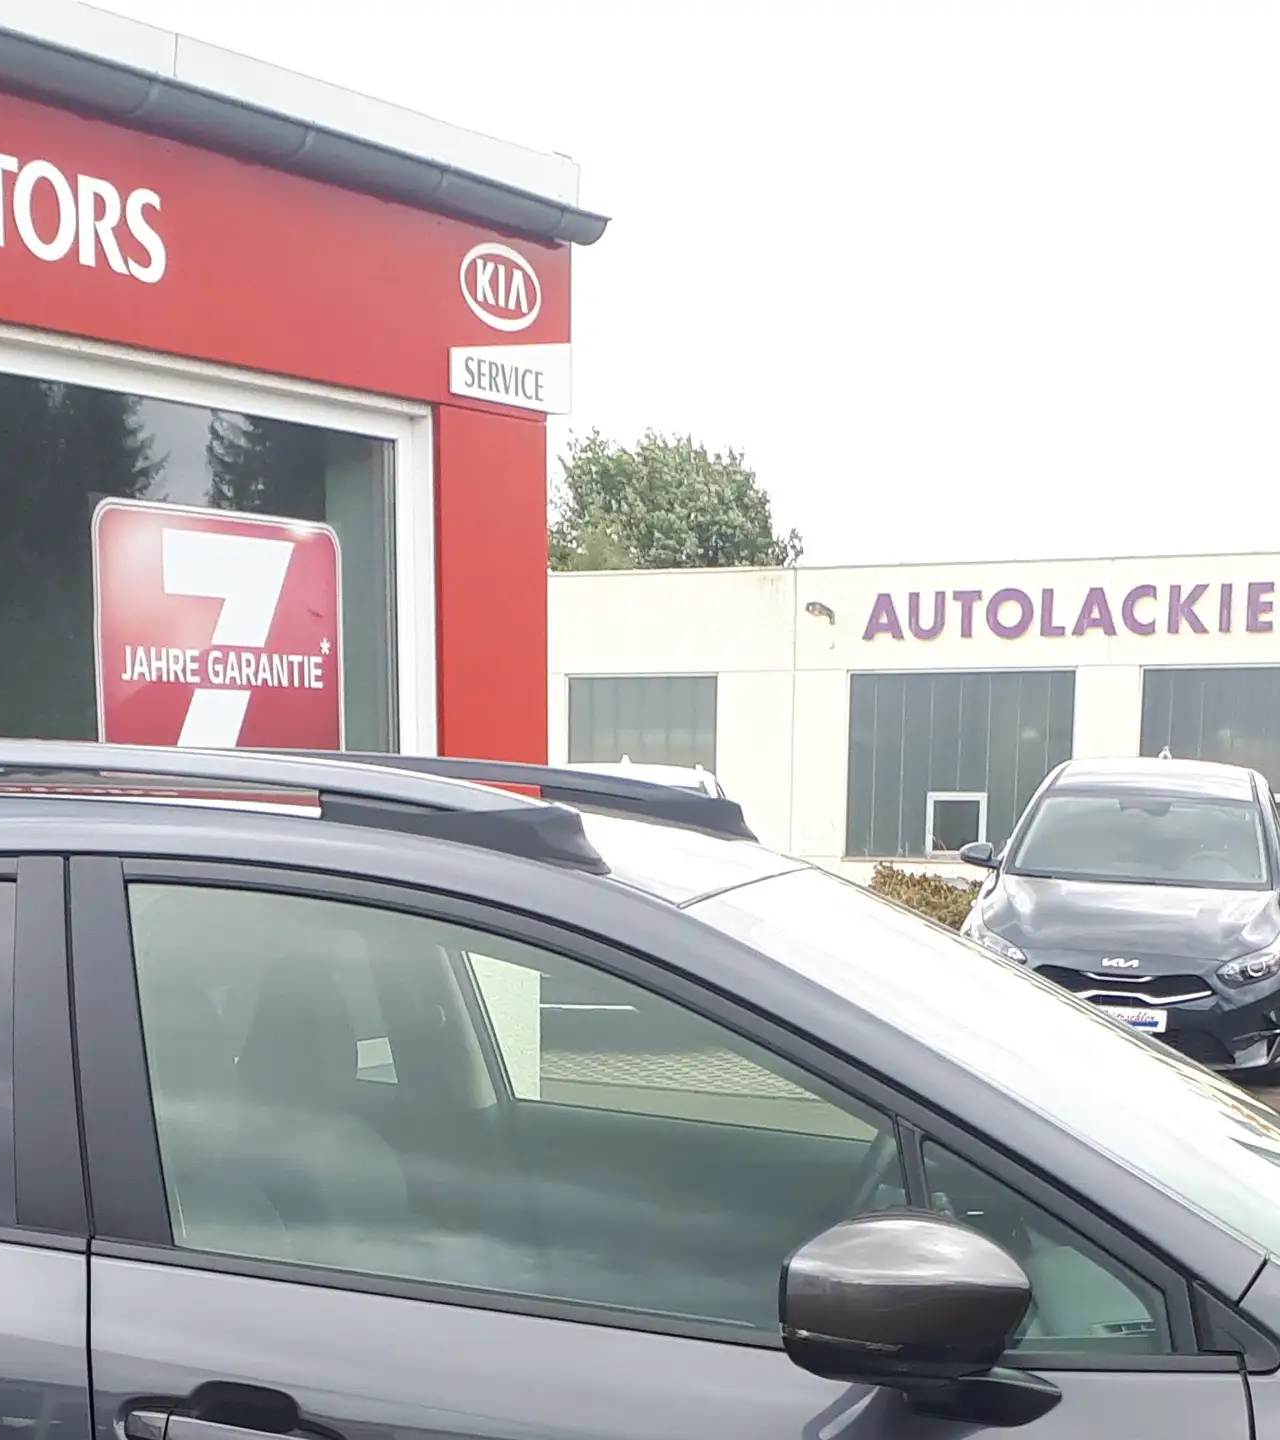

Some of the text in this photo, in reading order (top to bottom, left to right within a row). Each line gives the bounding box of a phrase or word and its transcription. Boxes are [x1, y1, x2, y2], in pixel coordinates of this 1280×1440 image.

[475, 257, 529, 314] KIA
[464, 355, 544, 402] SERVICE
[162, 527, 296, 749] 7
[121, 645, 201, 684] JAHRE
